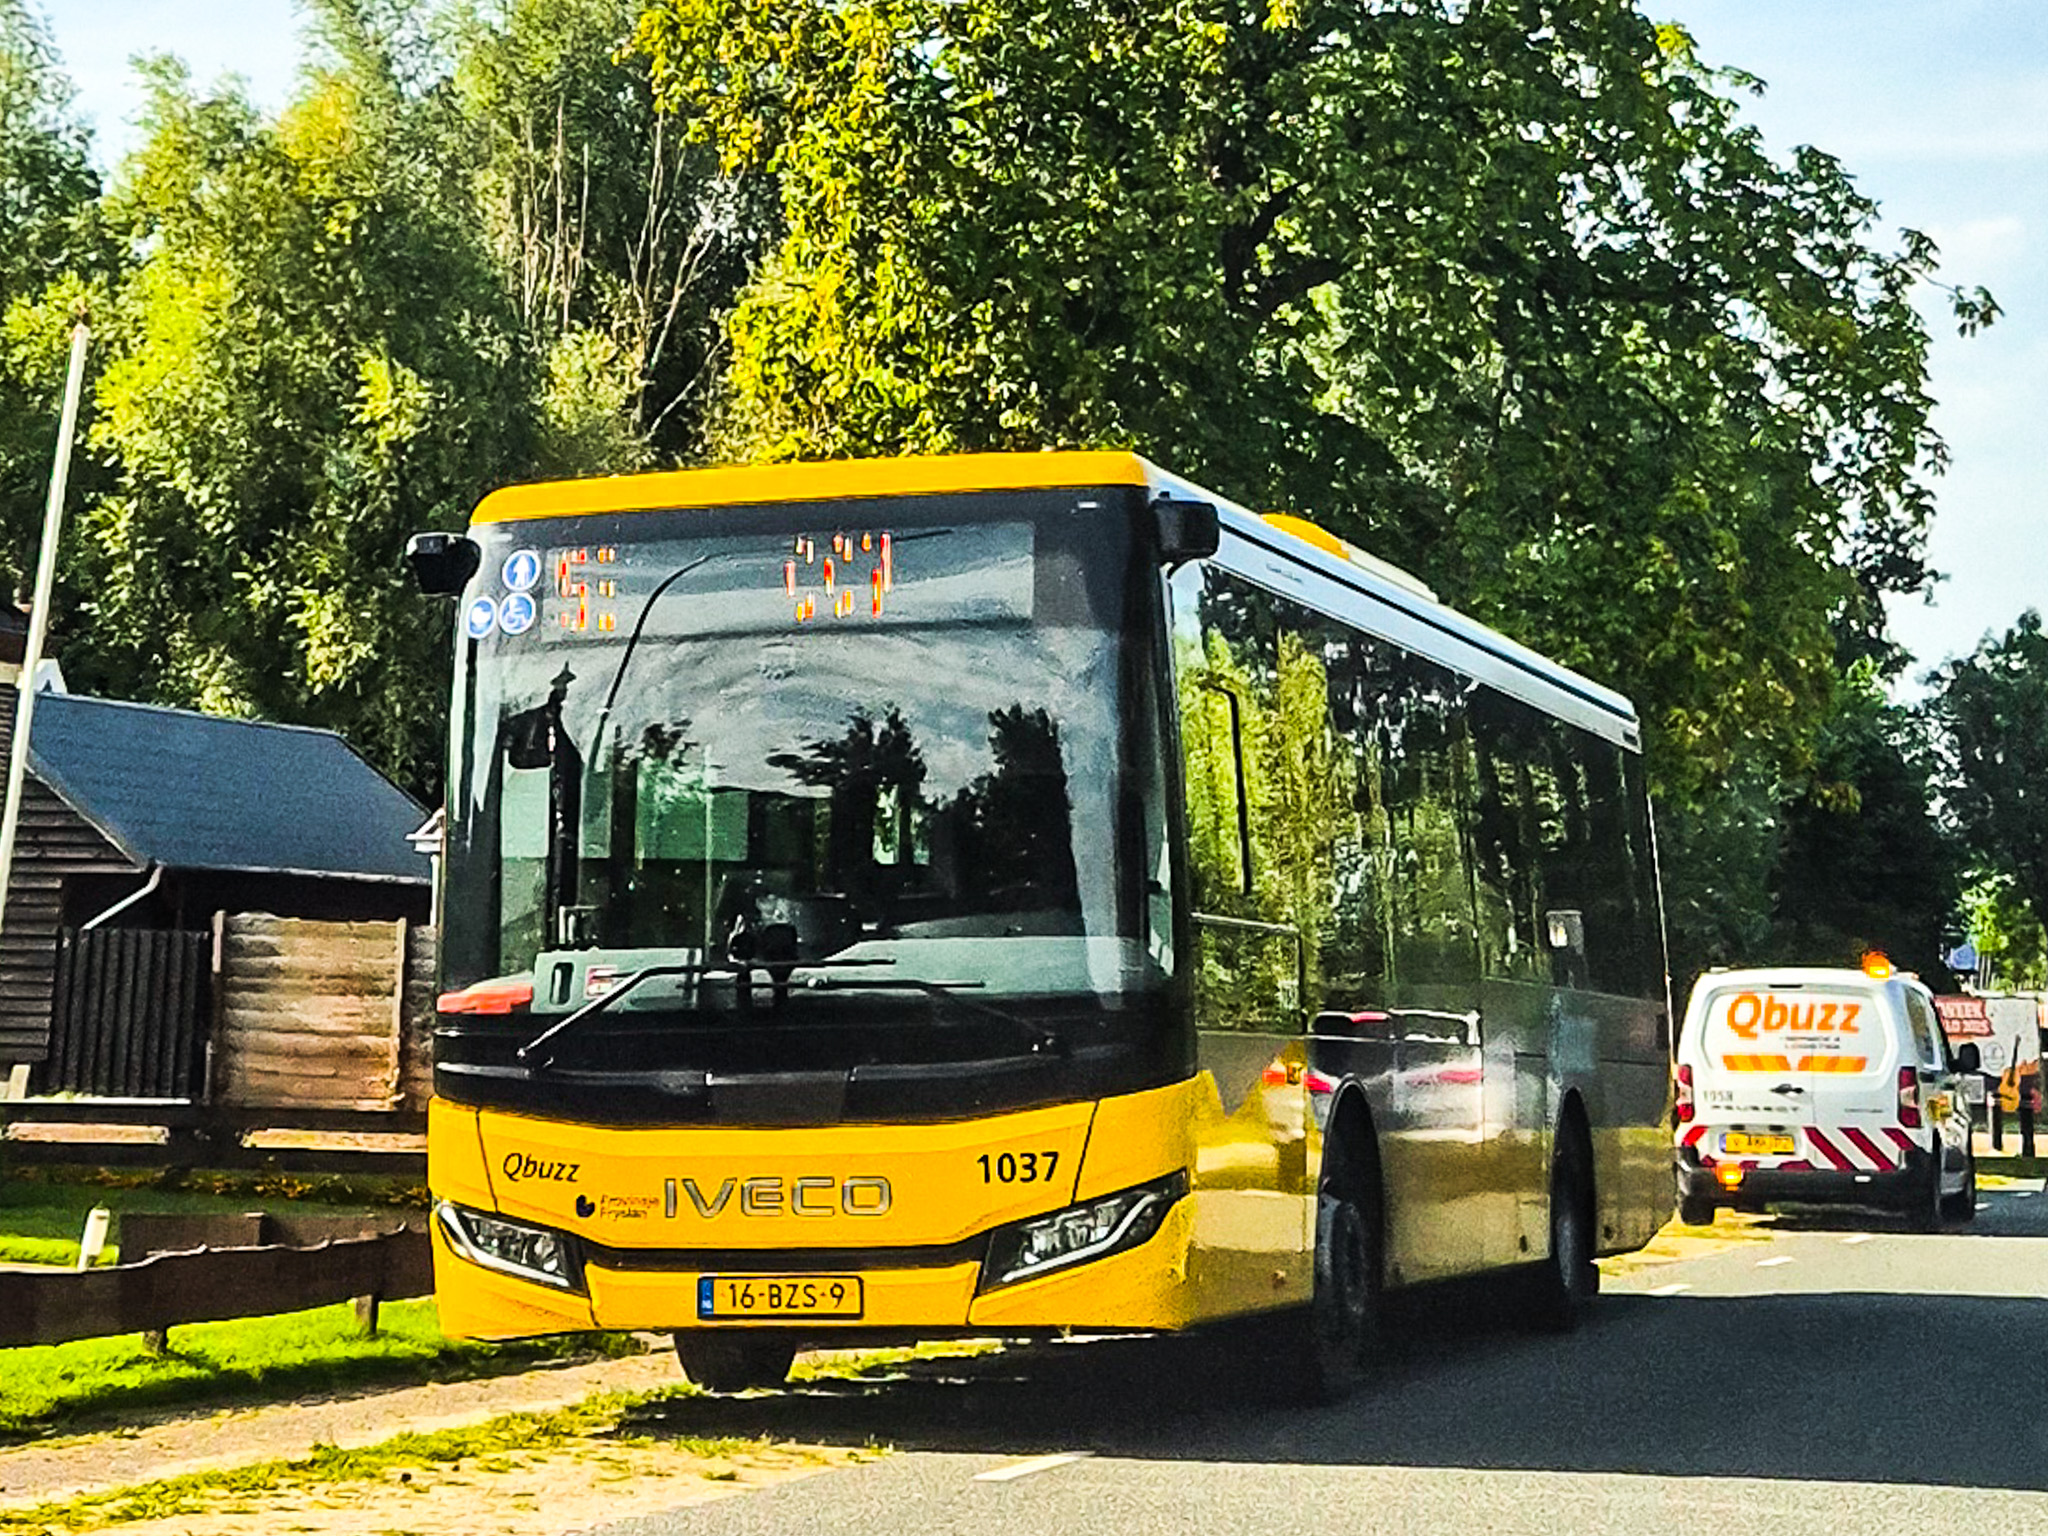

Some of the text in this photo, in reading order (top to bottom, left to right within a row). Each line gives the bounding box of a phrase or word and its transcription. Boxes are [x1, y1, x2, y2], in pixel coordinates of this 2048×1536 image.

[1727, 992, 1861, 1038] Qbuzz
[503, 1152, 580, 1182] Qbuzz
[976, 1151, 1060, 1184] 1037
[664, 1176, 892, 1218] IVECO
[728, 1282, 846, 1310] 16-BZS-9
